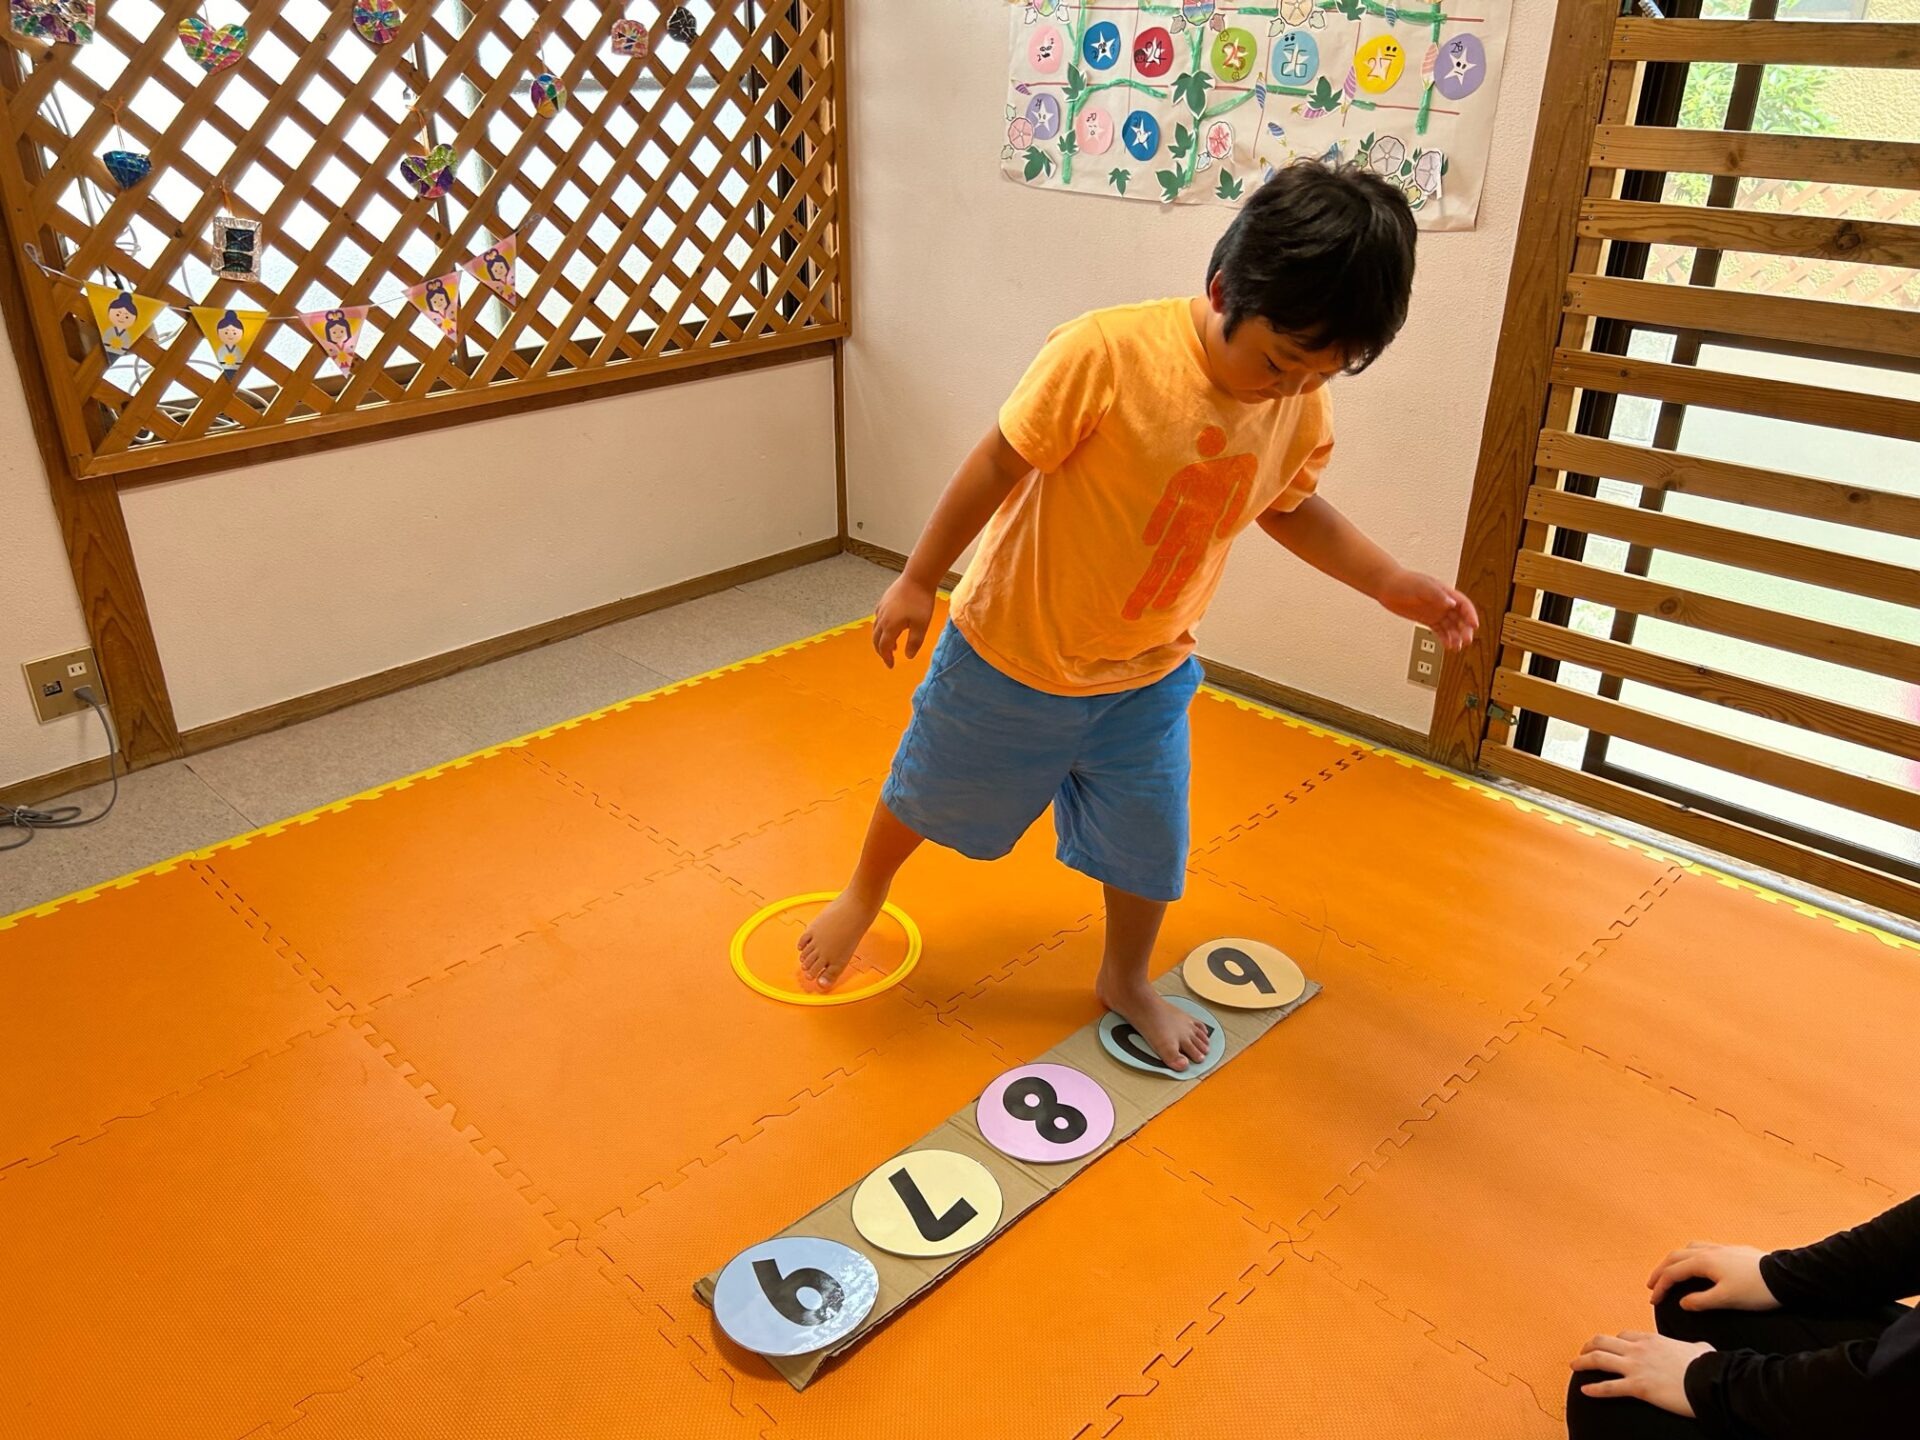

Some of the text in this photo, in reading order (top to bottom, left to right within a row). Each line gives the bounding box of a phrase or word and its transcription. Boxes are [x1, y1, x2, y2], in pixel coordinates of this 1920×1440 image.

[1222, 42, 1246, 70] 25
[1281, 48, 1308, 78] 26
[1367, 57, 1392, 80] 27
[1003, 1076, 1088, 1145] 8
[888, 1167, 979, 1243] 7
